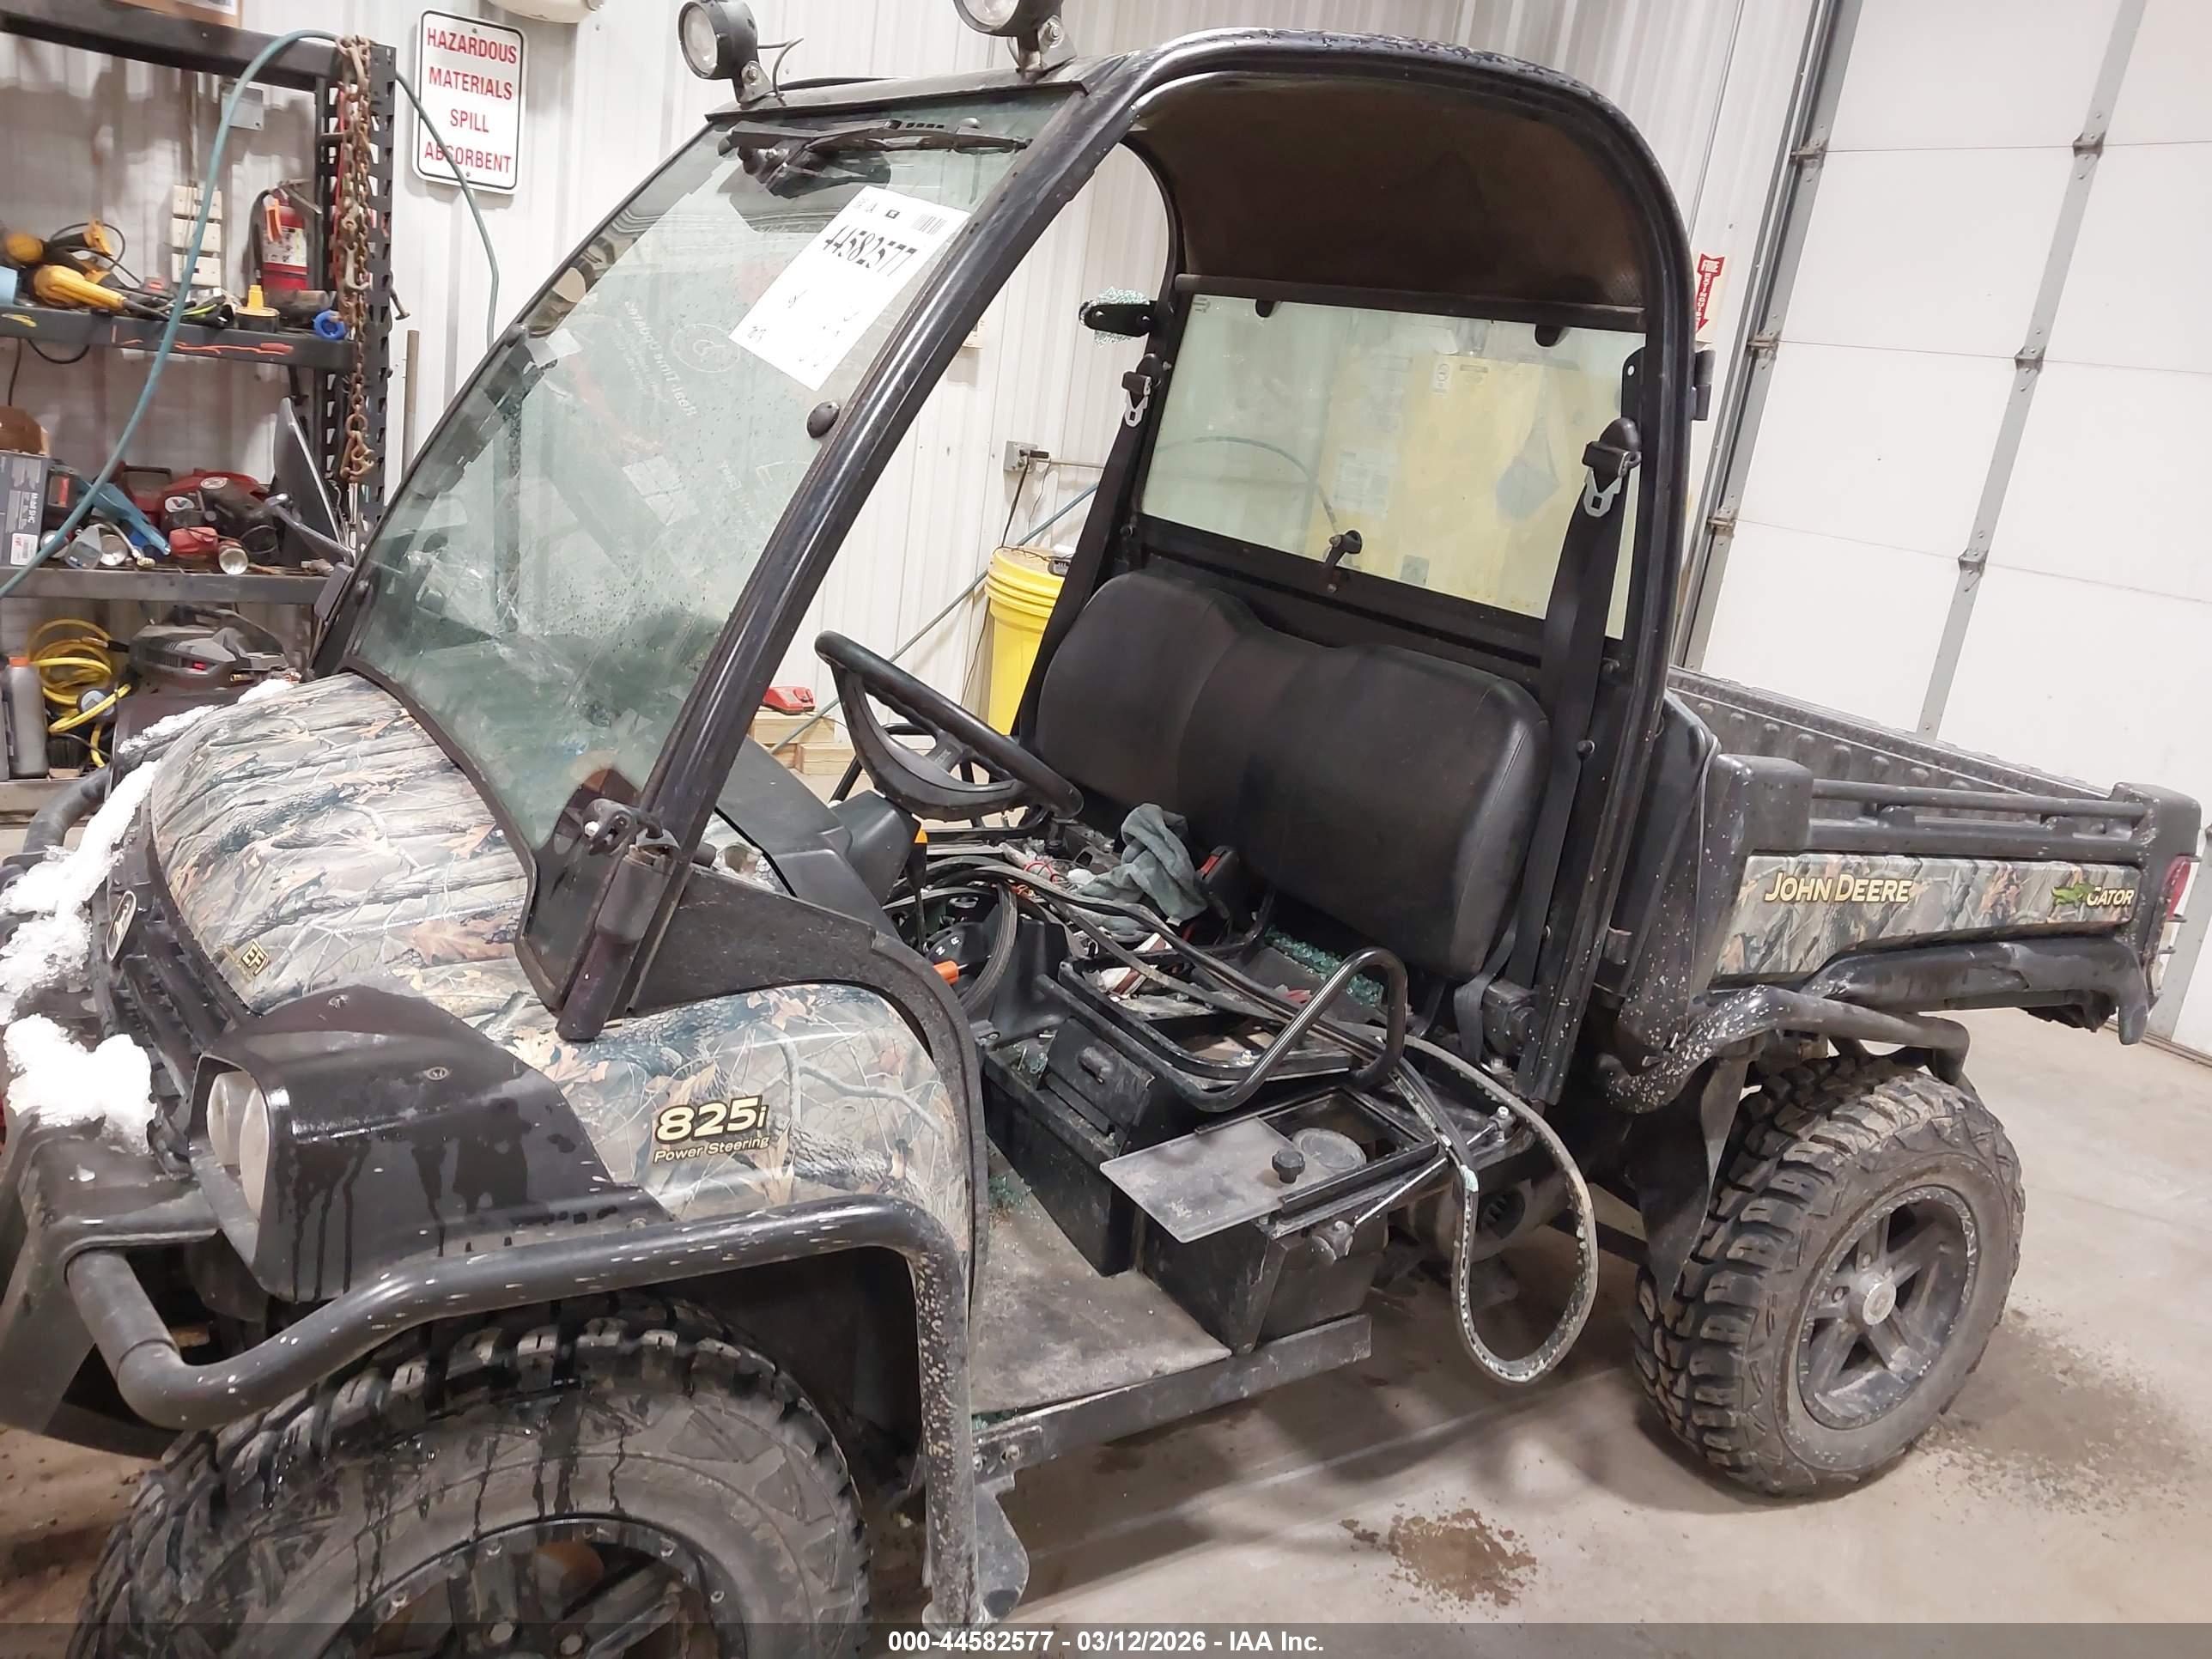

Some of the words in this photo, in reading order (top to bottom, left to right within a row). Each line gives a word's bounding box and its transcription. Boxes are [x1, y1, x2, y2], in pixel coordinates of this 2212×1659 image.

[427, 27, 517, 64] HAZARDOUS
[428, 66, 513, 100] MATERIALS
[450, 108, 489, 133] SPILL
[823, 224, 918, 277] 44582577
[1764, 871, 1833, 902] JOHN
[1834, 873, 1913, 902] DEERE
[2086, 885, 2135, 907] GATOR
[951, 936, 960, 945] R
[656, 1096, 769, 1143] 825i
[654, 1146, 704, 1164] Power
[707, 1136, 770, 1156] Steering
